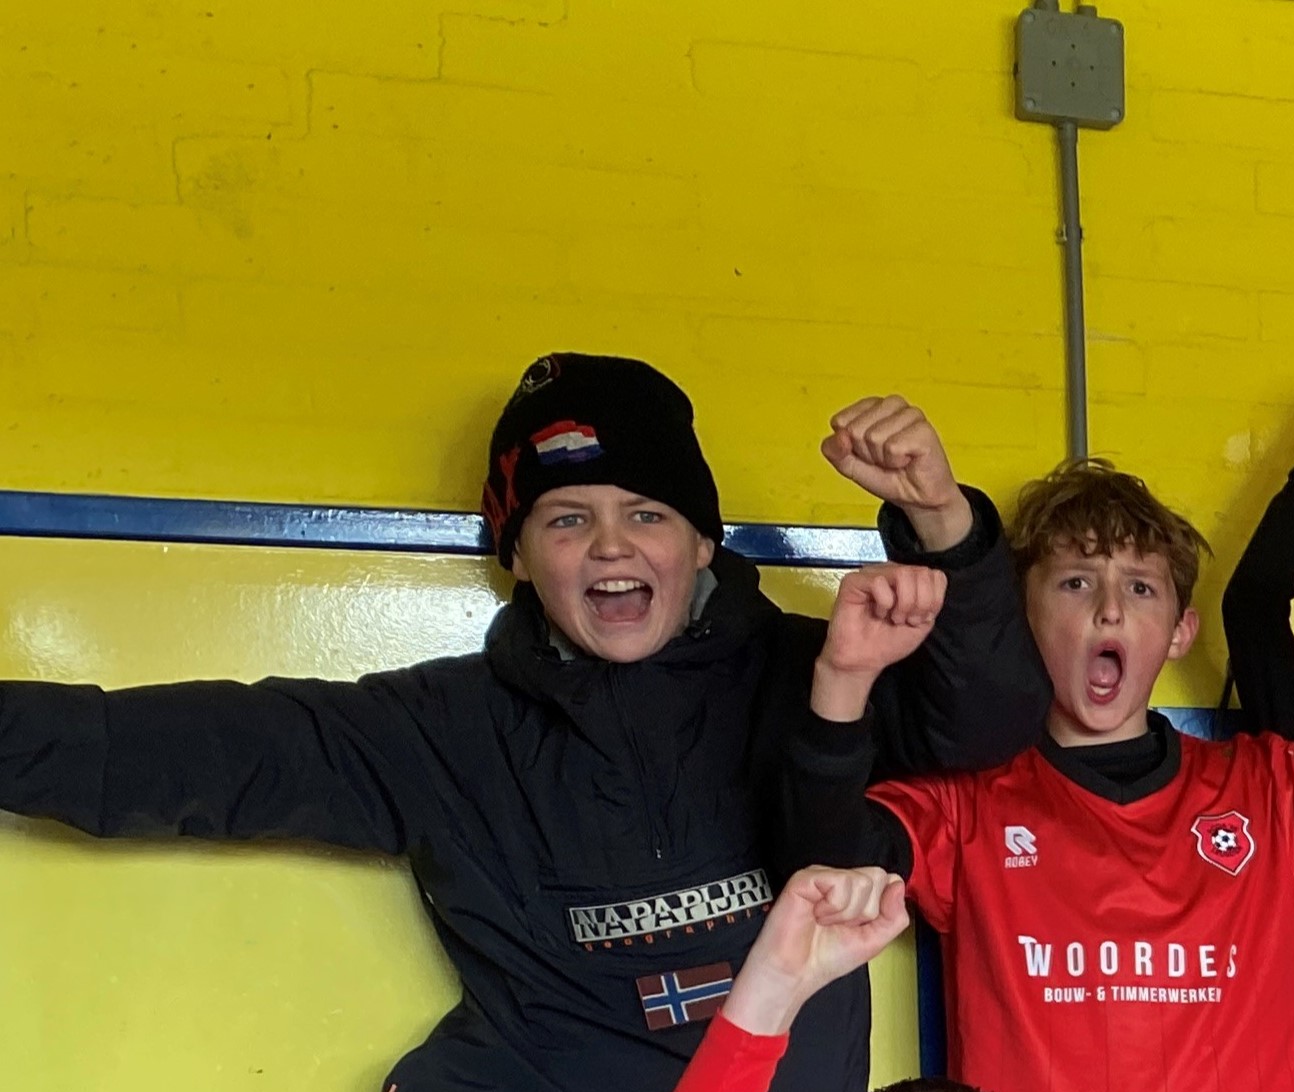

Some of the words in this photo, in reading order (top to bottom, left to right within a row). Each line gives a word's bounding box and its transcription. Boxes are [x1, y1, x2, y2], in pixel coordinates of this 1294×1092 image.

[574, 869, 769, 939] NAPAPIJRI
[1044, 986, 1092, 1003] BOUW-
[1096, 986, 1106, 1003] &
